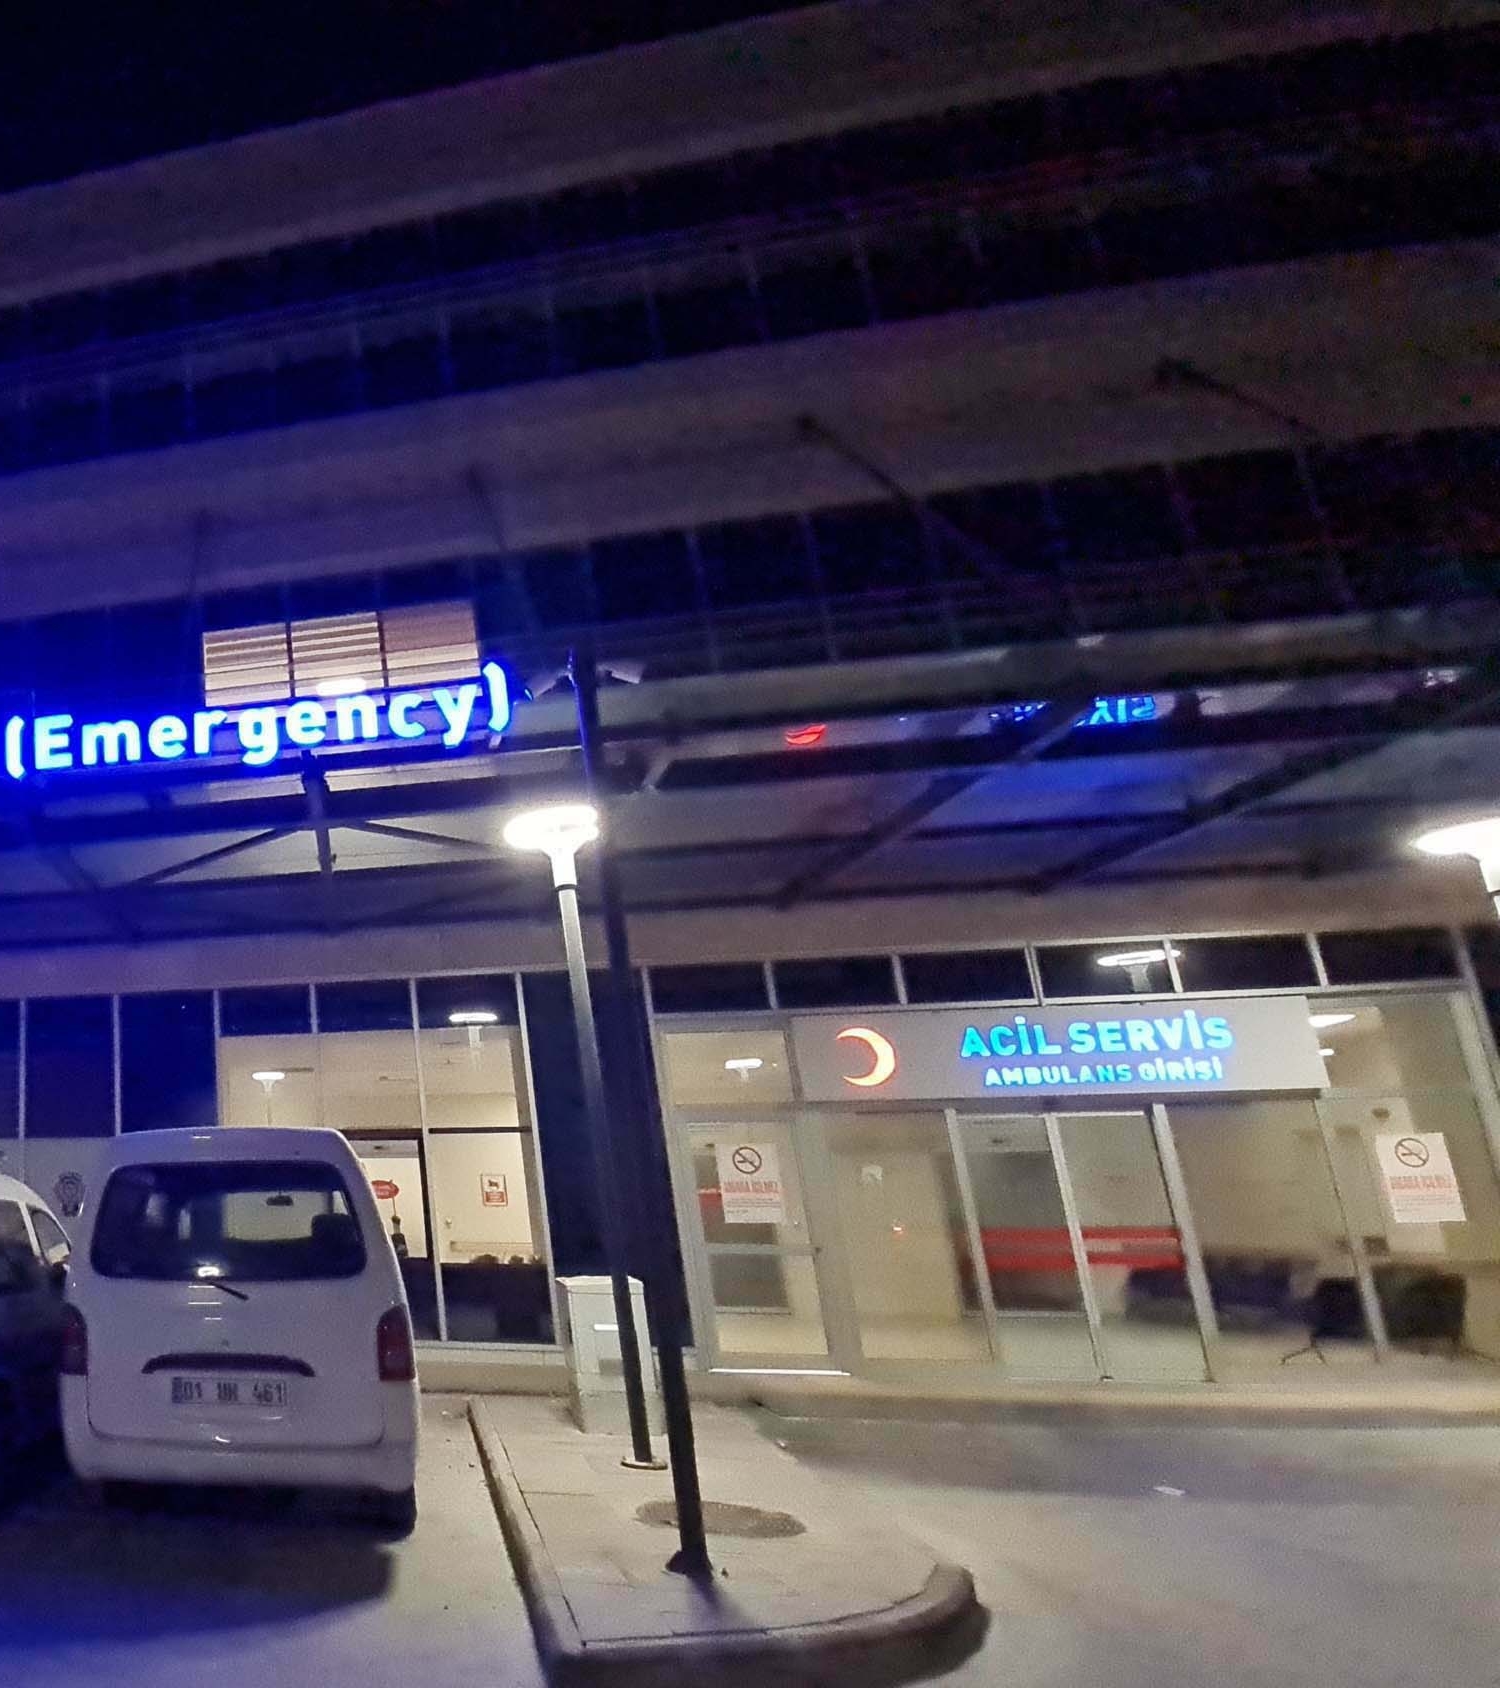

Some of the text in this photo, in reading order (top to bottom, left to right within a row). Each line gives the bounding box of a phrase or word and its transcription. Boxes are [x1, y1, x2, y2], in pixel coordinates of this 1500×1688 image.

[5, 661, 510, 779] (Emergency)
[961, 1009, 1234, 1058] ACİL SERVİS
[985, 1063, 1132, 1086] AMBULANS
